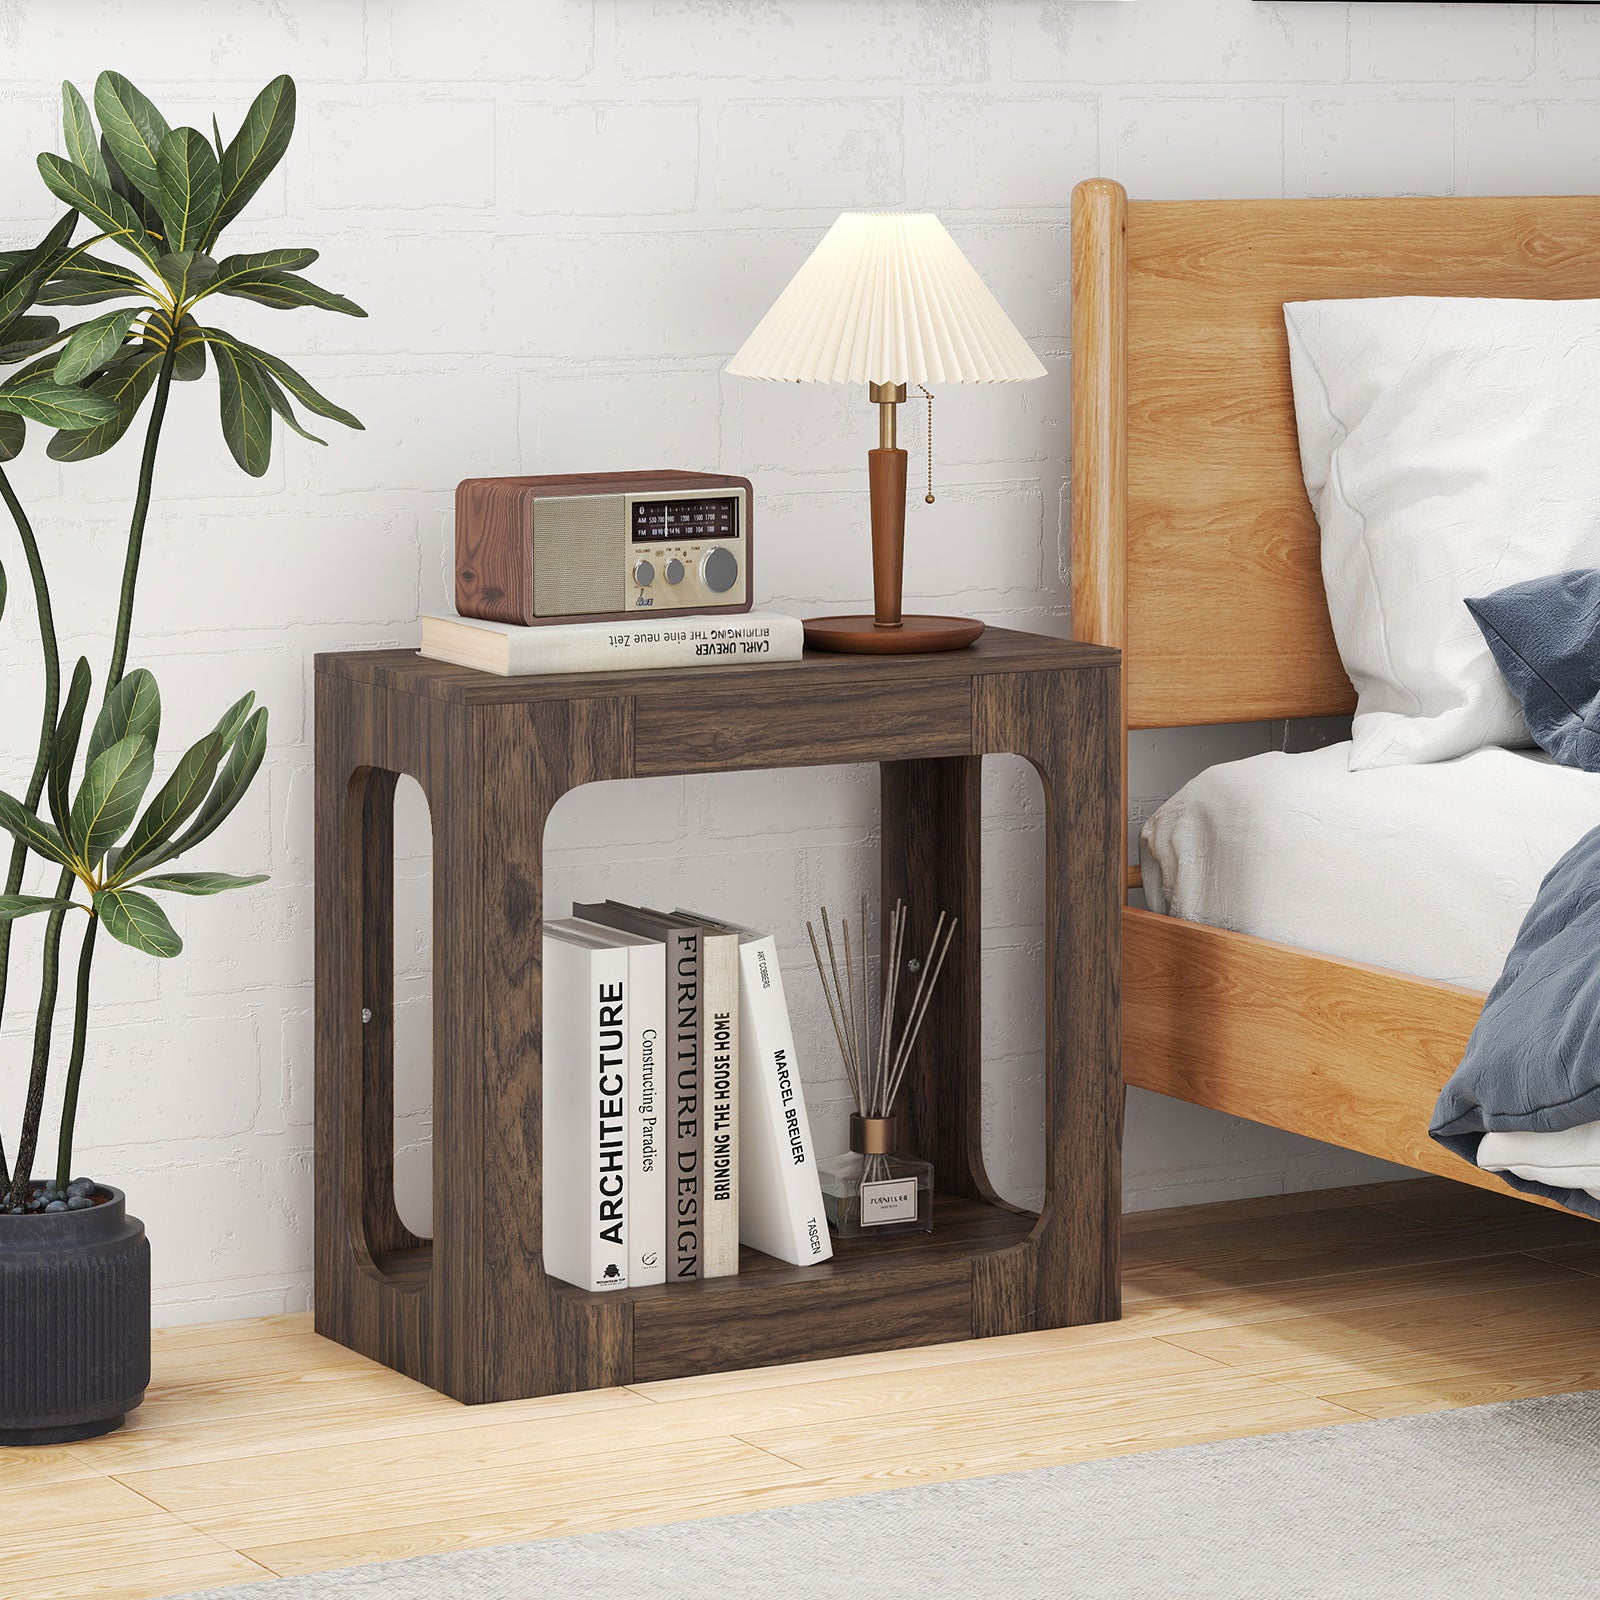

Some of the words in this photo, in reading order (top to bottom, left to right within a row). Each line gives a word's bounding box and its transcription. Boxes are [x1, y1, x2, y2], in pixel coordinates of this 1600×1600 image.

[609, 634, 631, 648] Zeit
[634, 633, 660, 644] neue
[664, 631, 687, 645] eine
[757, 951, 765, 962] ART
[677, 934, 698, 1139] FURNITURE
[714, 1012, 731, 1051] HOME
[639, 1029, 658, 1114] Constructing
[714, 1054, 731, 1100] HOUSE
[599, 982, 624, 1245] ARCHITECTURE
[714, 1103, 731, 1131] THE
[773, 1049, 794, 1107] MARCEL
[785, 1108, 805, 1166] BREUER
[642, 1116, 658, 1173] Paradies
[714, 1134, 731, 1201] BRINGING
[677, 1149, 698, 1278] DESIGN
[807, 1217, 822, 1255] TASCEN
